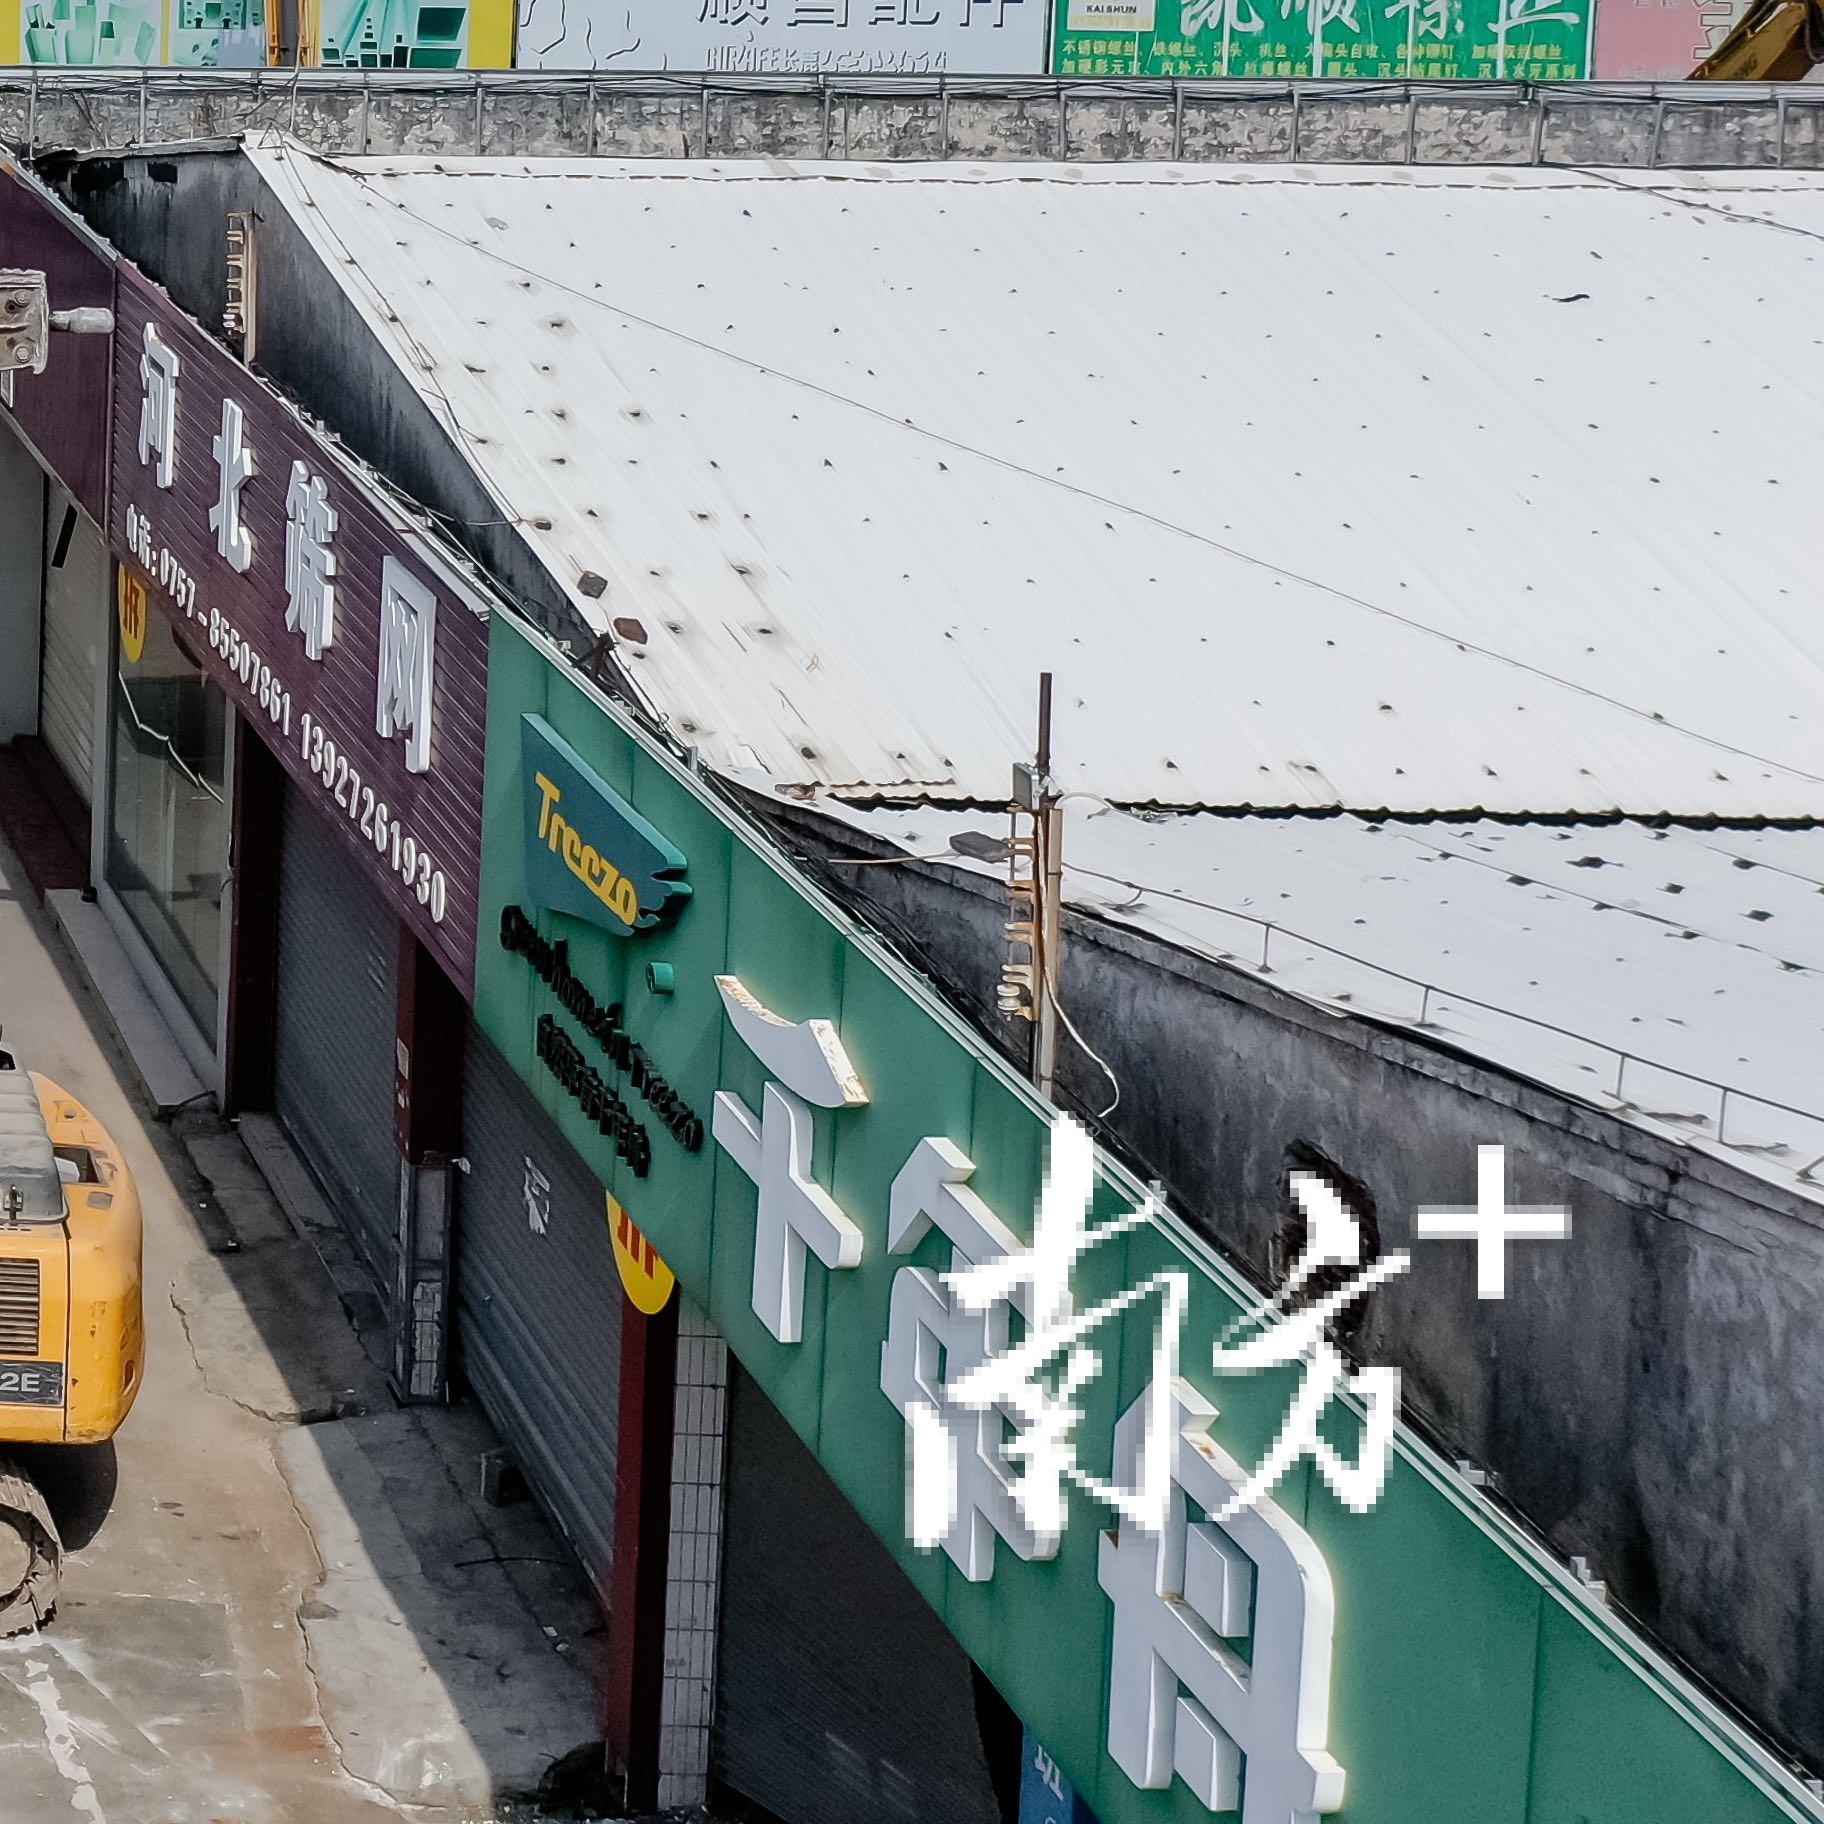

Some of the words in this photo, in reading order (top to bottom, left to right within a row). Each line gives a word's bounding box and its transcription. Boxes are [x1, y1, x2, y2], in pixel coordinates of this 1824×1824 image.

[138, 321, 438, 775] 河北筛网
[300, 711, 448, 924] 13927261930
